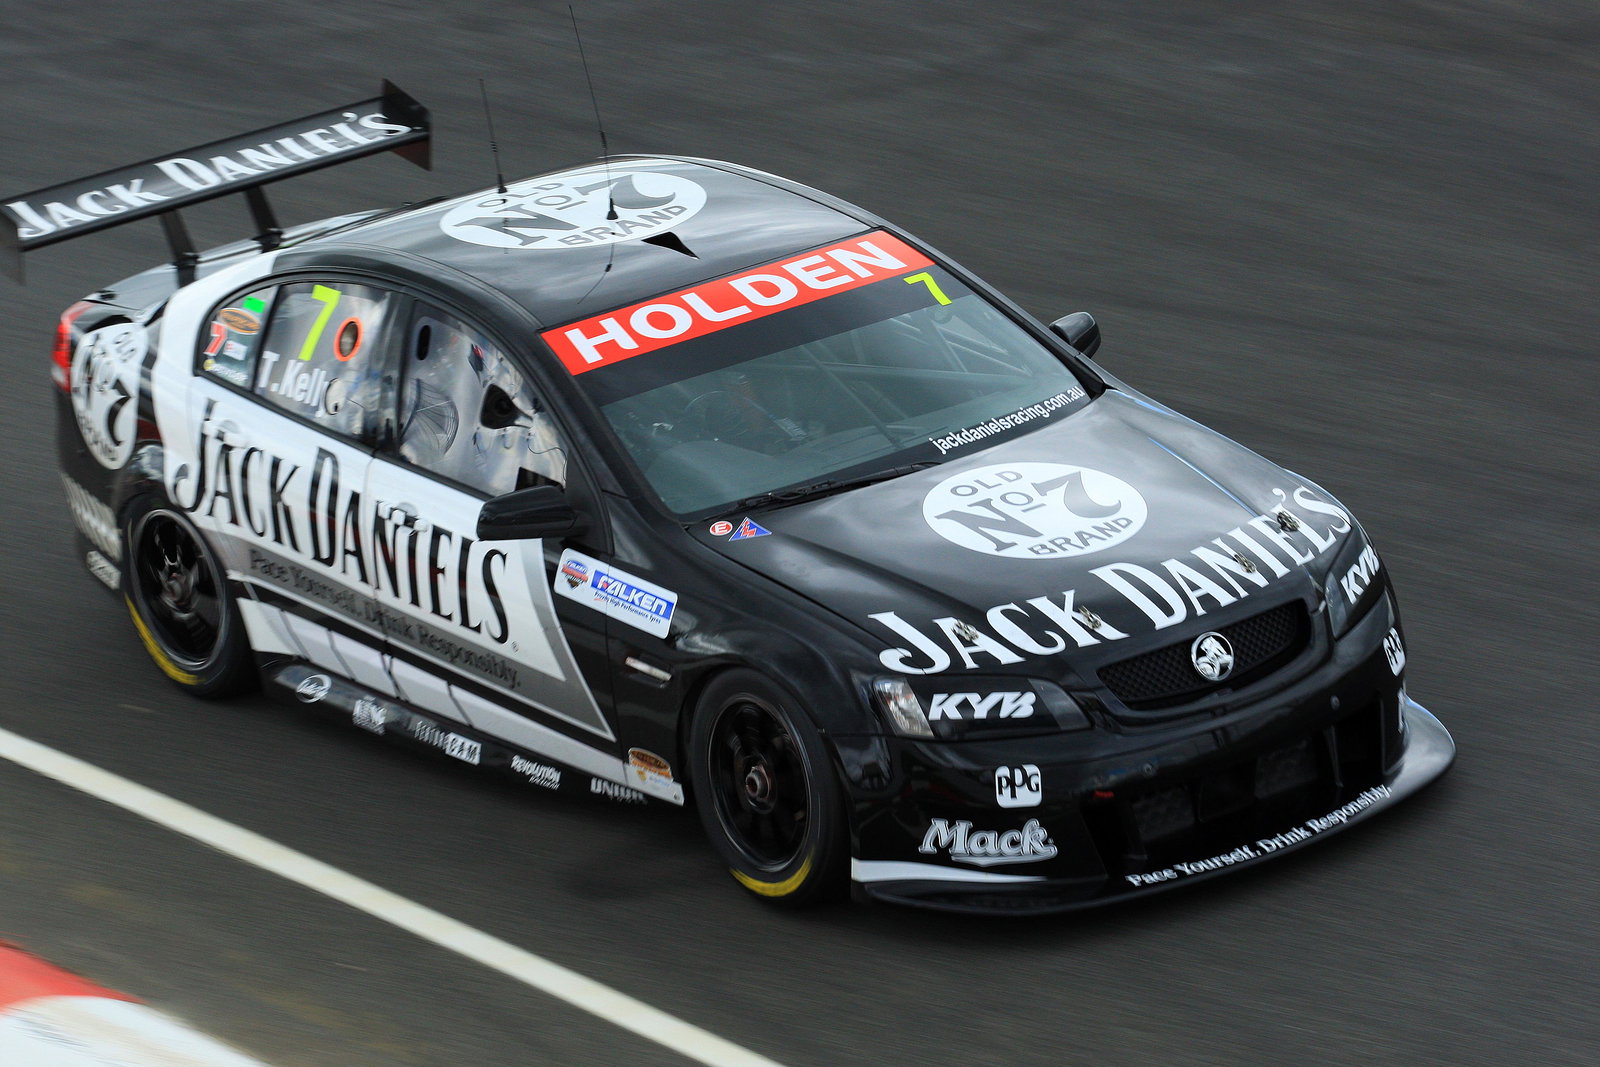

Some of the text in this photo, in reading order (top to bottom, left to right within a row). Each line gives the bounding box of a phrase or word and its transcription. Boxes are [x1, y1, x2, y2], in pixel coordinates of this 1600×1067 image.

[7, 111, 411, 240] JACK DANIEL'S
[477, 182, 564, 208] OLD
[576, 174, 676, 209] 7
[557, 204, 688, 246] BRAND
[564, 241, 908, 364] HOLDEN
[903, 272, 952, 306] 7
[298, 285, 342, 361] 7
[929, 385, 1086, 455] jackdanielsracing.com.au
[173, 398, 302, 553] JACK
[950, 471, 1023, 497] OLD
[1031, 471, 1122, 519] 7
[1028, 517, 1133, 555] BRAND
[597, 574, 668, 616] FALKEN
[868, 486, 1351, 676] JACK DANIEL'S
[1340, 543, 1380, 605] KYB
[928, 691, 1036, 720] KYB
[996, 764, 1042, 804] PPG
[918, 818, 1058, 862] Mack
[1125, 869, 1178, 887] Pace
[1255, 826, 1313, 854] Drink
